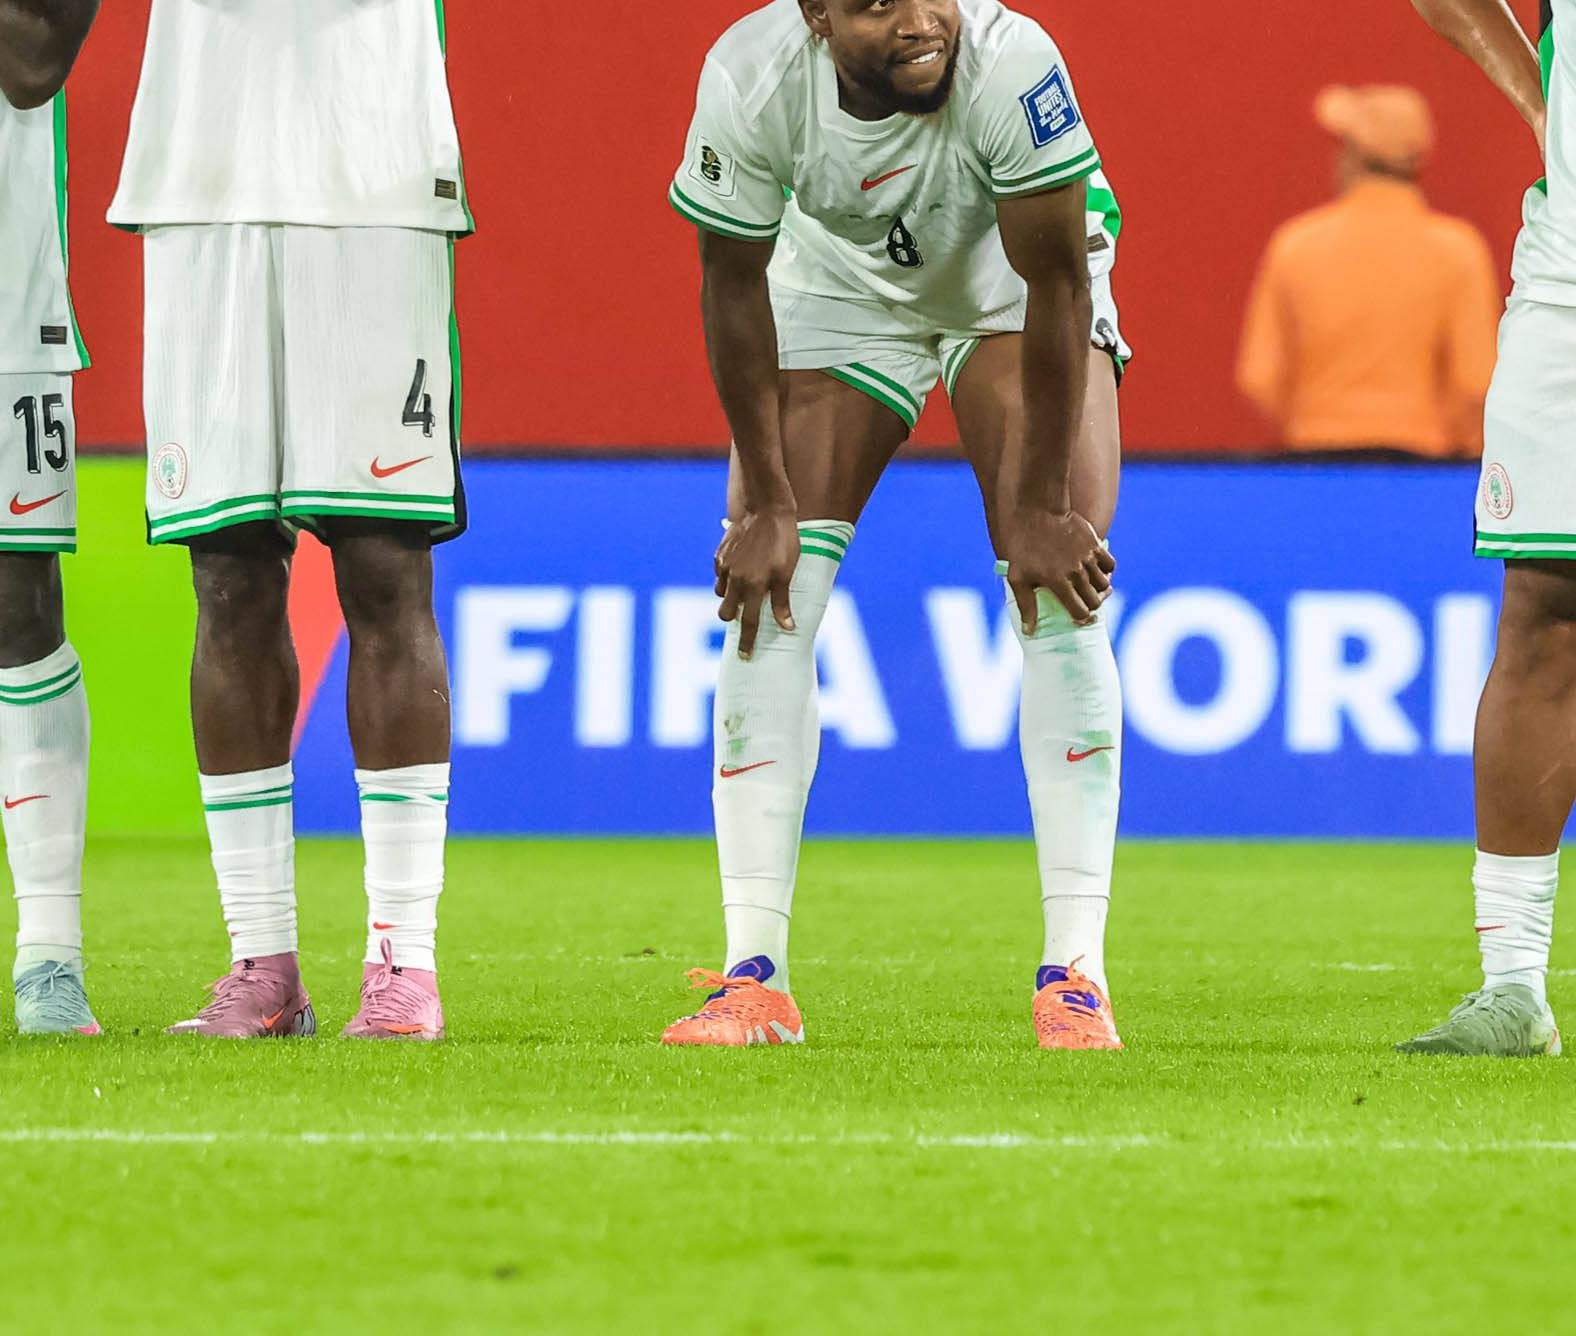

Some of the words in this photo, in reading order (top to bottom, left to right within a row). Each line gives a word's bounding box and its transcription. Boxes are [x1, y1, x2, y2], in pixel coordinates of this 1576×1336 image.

[887, 217, 924, 269] 8
[13, 392, 70, 474] 15
[402, 358, 435, 438] 4
[452, 584, 899, 750] FIFA
